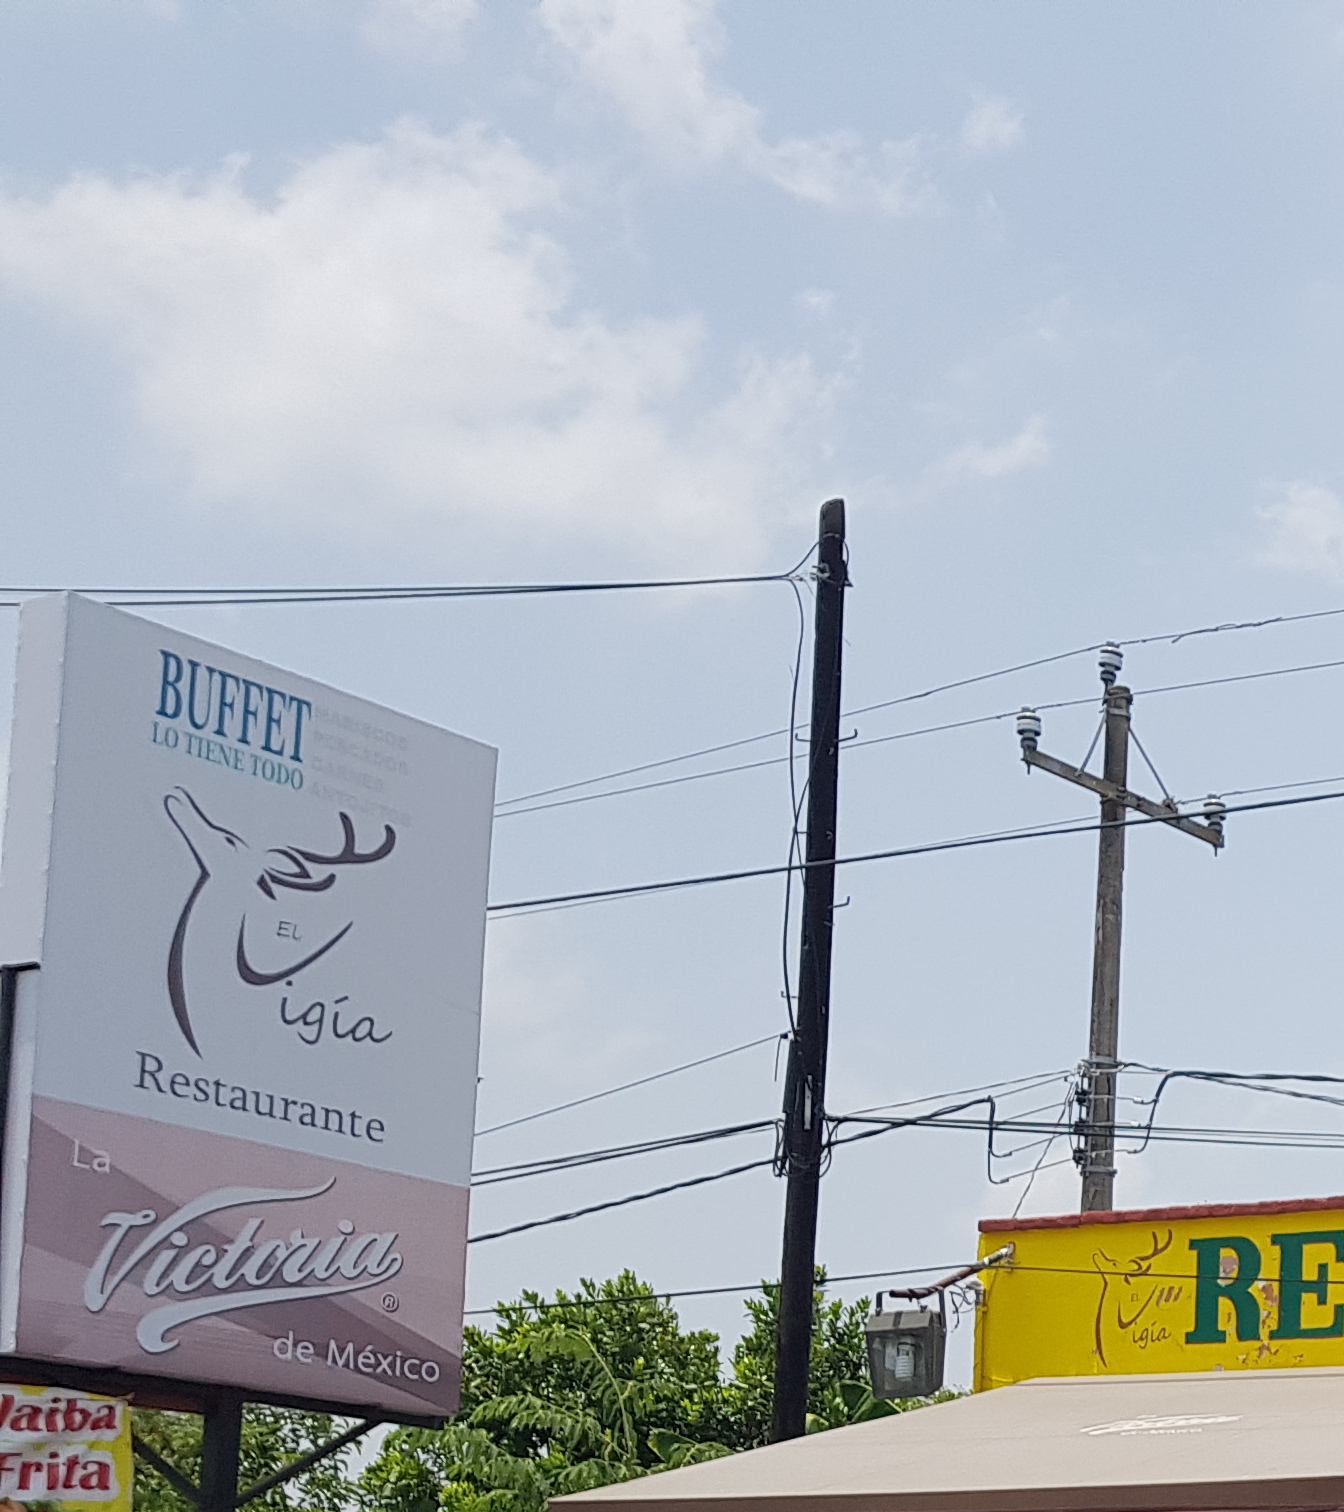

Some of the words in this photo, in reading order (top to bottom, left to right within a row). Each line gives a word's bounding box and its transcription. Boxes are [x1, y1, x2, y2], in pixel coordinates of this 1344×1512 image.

[155, 649, 312, 763] BUFFET
[152, 721, 179, 750] LO
[184, 731, 245, 771] TIENE
[249, 753, 305, 790] TODO
[276, 920, 302, 941] EL
[134, 1050, 386, 1143] Restaurante
[71, 1138, 111, 1173] La
[84, 1176, 404, 1353] Victoria
[273, 1330, 313, 1364] de
[326, 1338, 441, 1384] México
